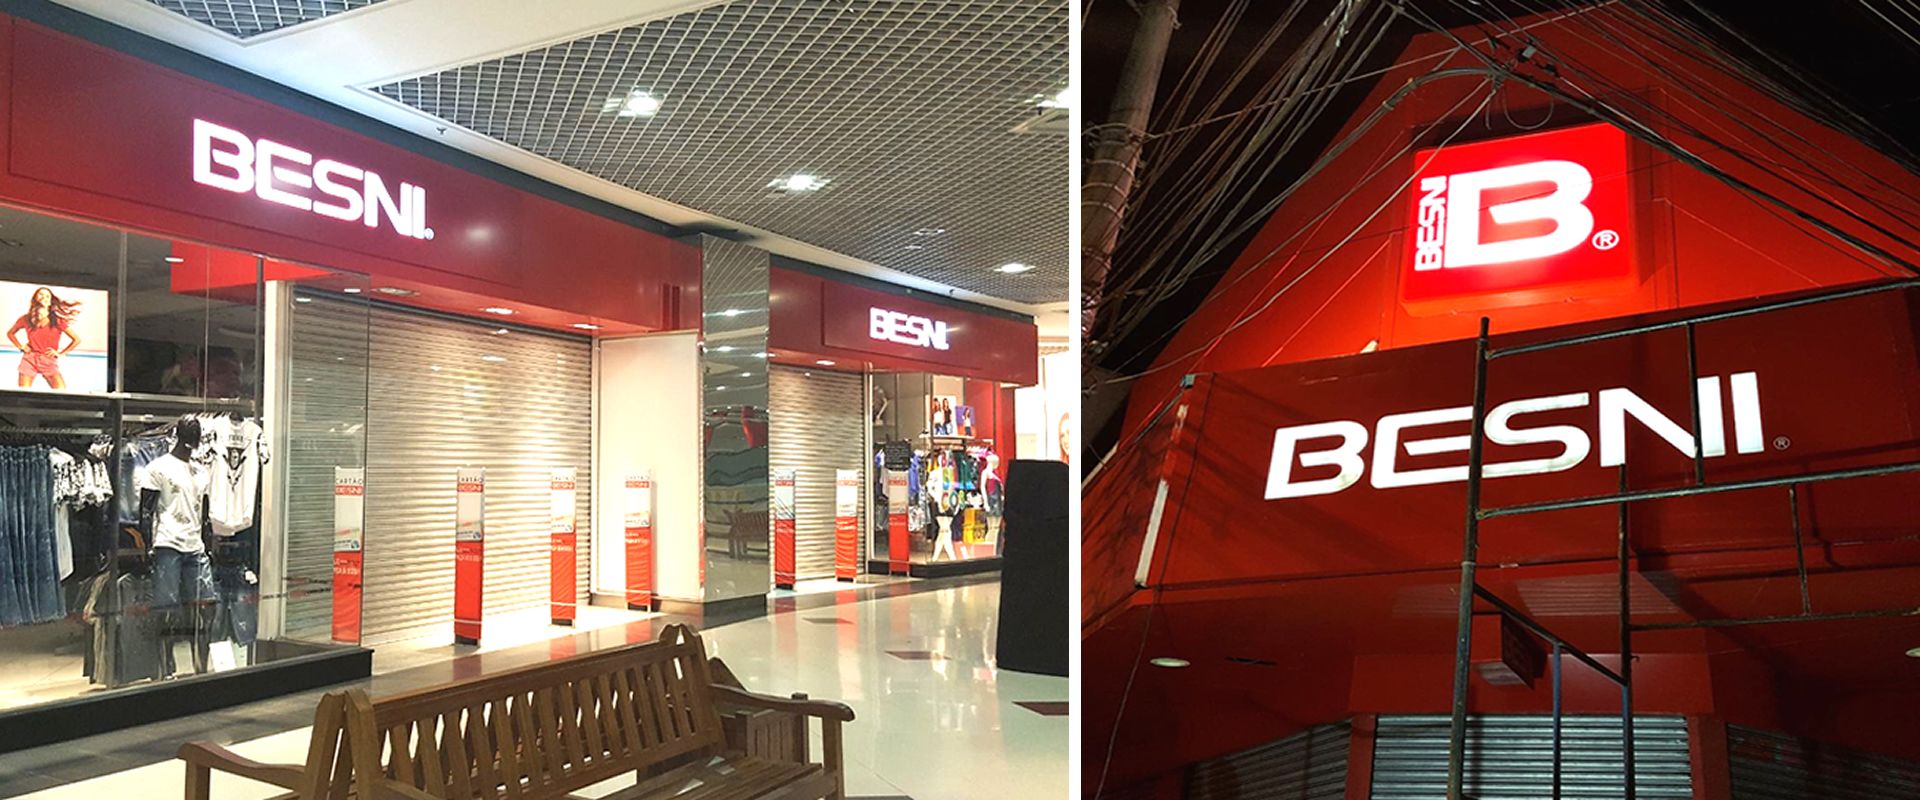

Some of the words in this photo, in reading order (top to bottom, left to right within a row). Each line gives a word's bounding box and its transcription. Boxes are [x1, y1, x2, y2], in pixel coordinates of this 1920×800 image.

[193, 118, 426, 240] BESNI
[1414, 175, 1447, 271] BESNI
[1444, 160, 1594, 269] B
[869, 307, 947, 350] BESNI
[1264, 371, 1764, 500] BESNI
